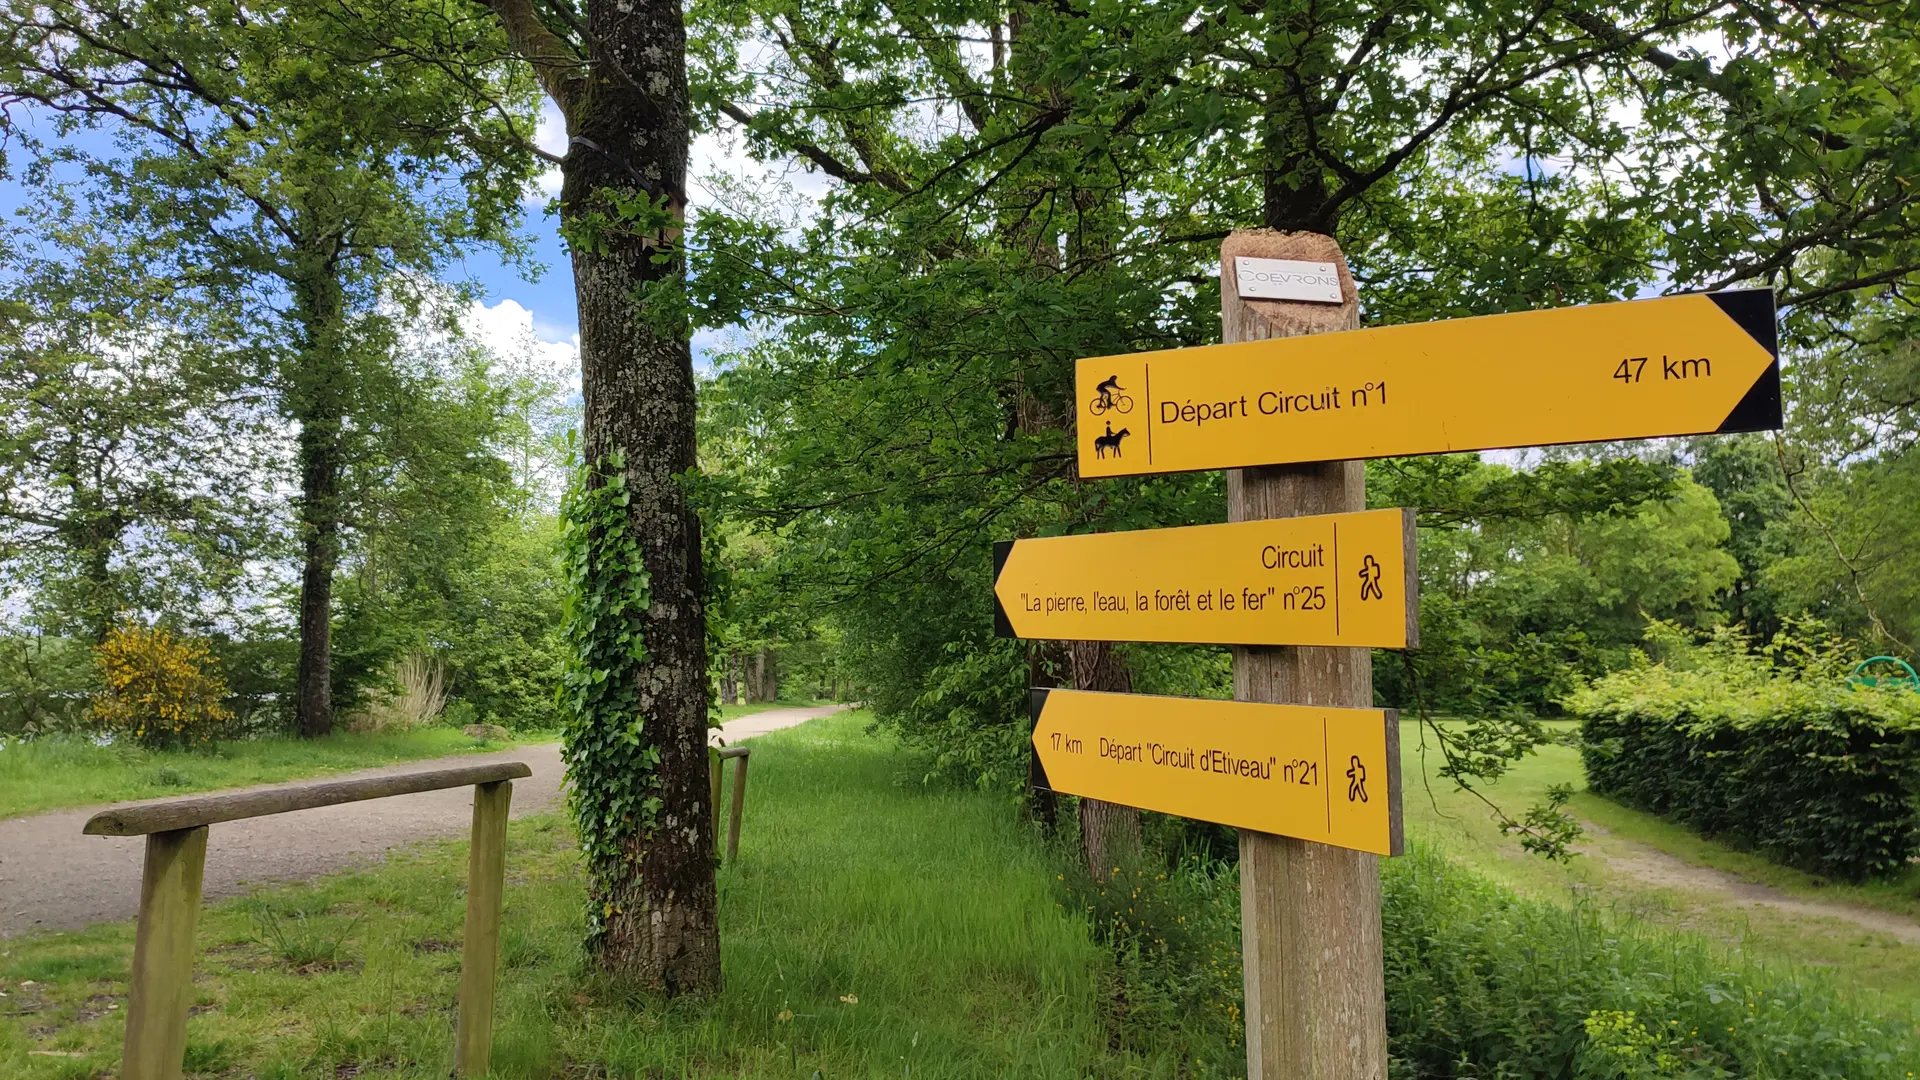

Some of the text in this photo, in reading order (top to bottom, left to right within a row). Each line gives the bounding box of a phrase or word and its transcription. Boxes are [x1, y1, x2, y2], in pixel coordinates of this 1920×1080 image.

[1161, 355, 1711, 426] Départ Circuit n°1 47 km
[1262, 544, 1324, 569] Circuit
[1021, 586, 1325, 616] "La pierre, l'eau, la forêt et le fer" n°25
[1051, 733, 1317, 786] 17 km Départ "Circuit d'Etiveau" n°21
